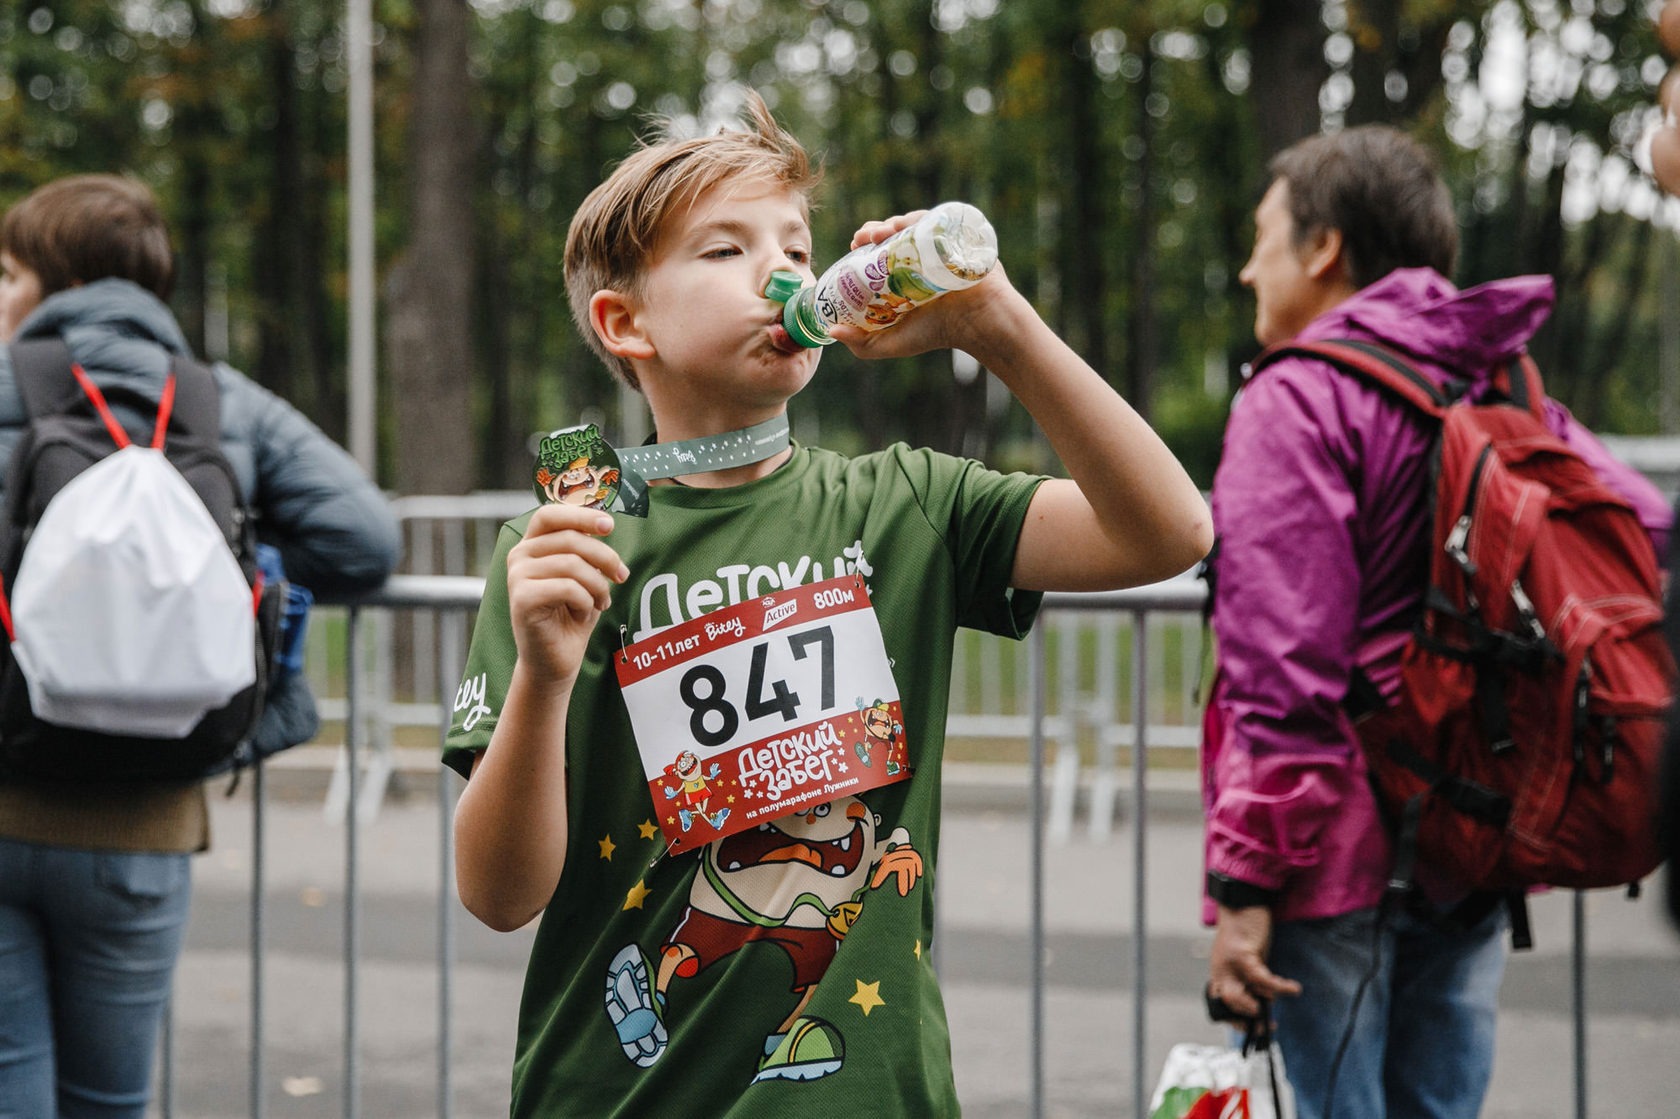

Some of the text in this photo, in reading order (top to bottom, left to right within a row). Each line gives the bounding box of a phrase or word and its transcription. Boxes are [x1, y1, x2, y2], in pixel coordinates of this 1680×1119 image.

[704, 616, 747, 641] Bitey
[766, 603, 796, 624] Active
[680, 625, 836, 747] 847
[737, 721, 842, 788] Детский
[746, 777, 860, 820] на полумарафоне Лужники
